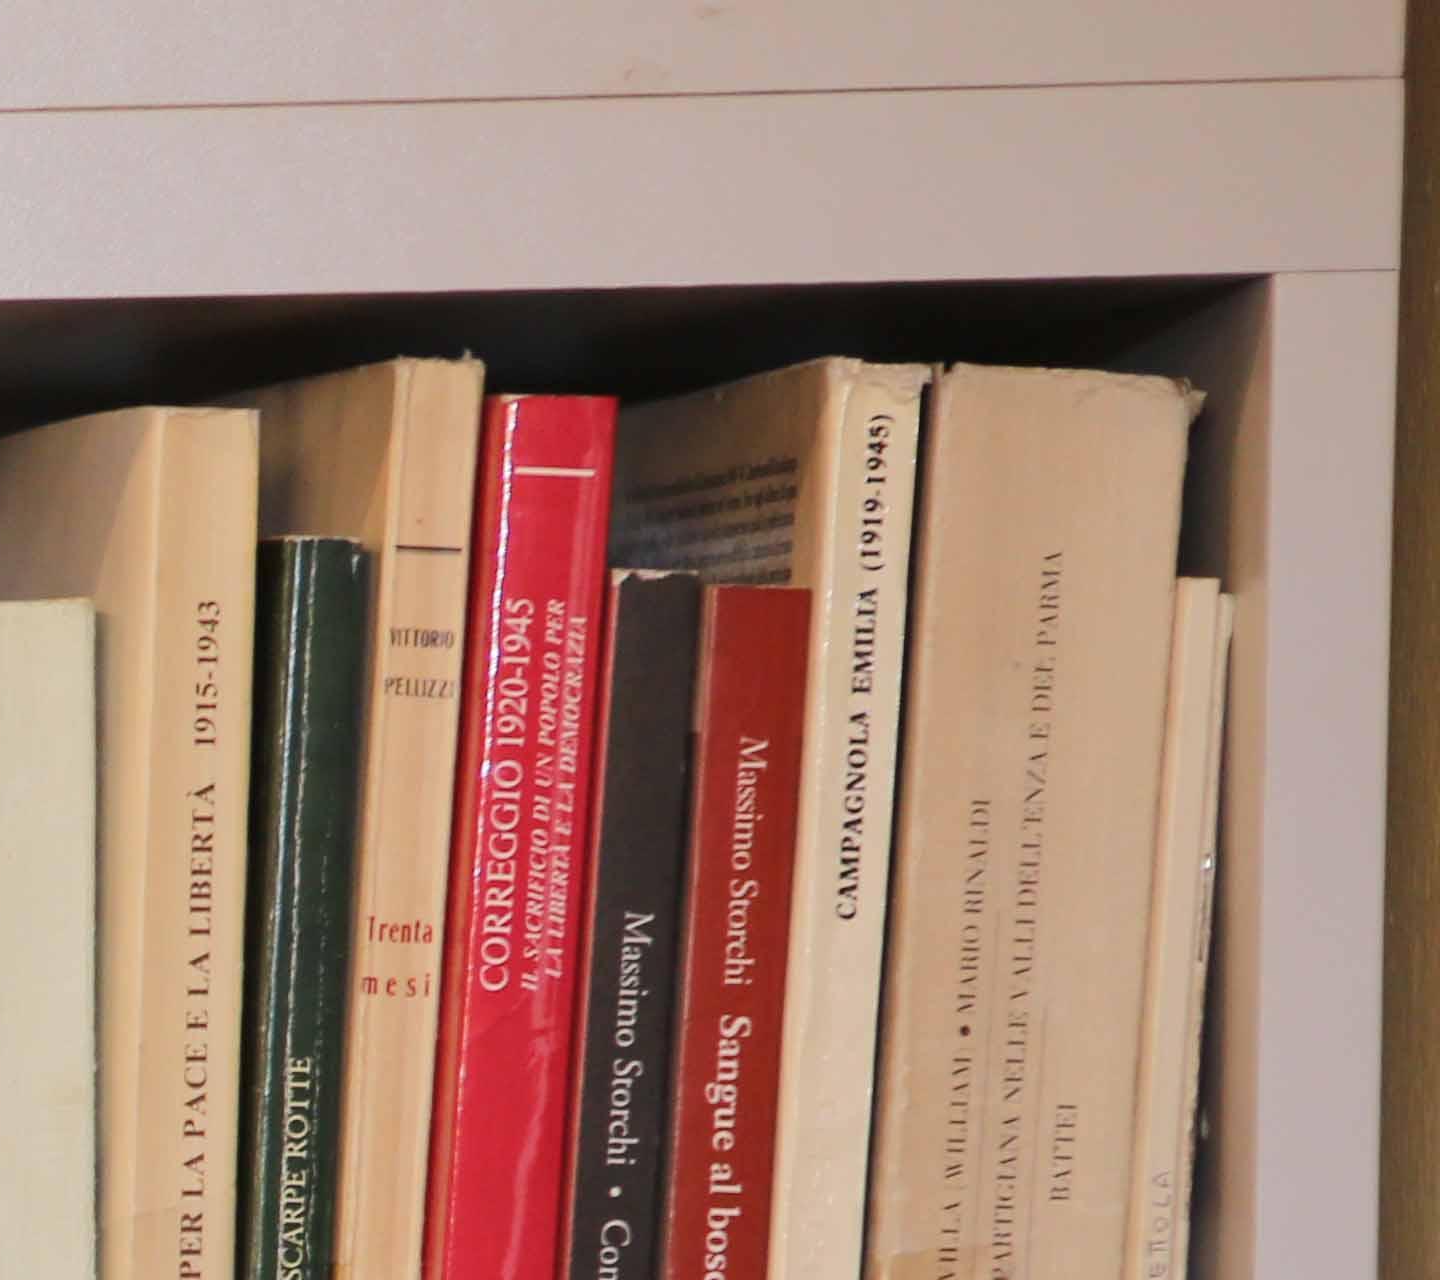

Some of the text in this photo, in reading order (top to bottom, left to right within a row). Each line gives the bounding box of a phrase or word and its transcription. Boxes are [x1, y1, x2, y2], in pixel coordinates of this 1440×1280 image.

[834, 413, 890, 921] CAMPAGNOLA EMILIA (1919-1945)
[480, 597, 532, 992] CORREGGIO 1920-1945
[726, 735, 772, 872] Massimo
[179, 597, 222, 1280] PER PACE LIBERTÀ 1915-1943
[724, 878, 760, 986] Storchi
[703, 1014, 750, 1152] Sangue
[710, 1162, 742, 1197] al
